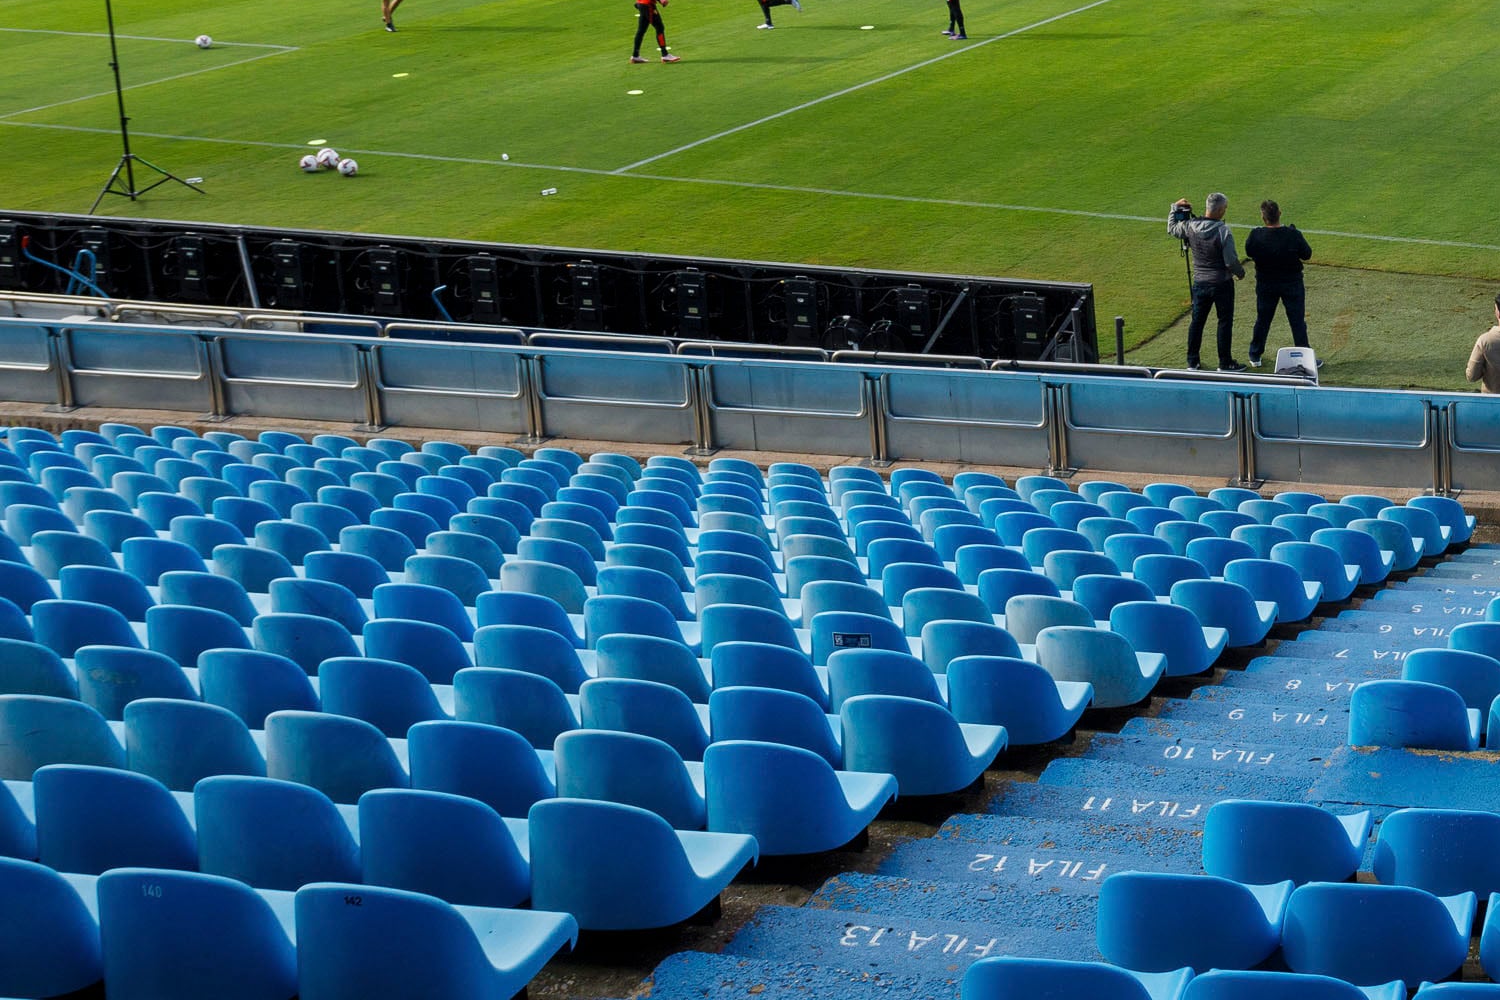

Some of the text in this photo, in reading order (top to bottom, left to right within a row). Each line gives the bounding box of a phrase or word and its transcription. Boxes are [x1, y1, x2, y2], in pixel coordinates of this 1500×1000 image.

[1411, 604, 1485, 617] FILA 5
[1379, 624, 1393, 634] 6
[1334, 648, 1350, 658] 7
[1285, 679, 1302, 690] 8
[1228, 708, 1329, 726] FILA 9
[1163, 745, 1275, 765] FILA 10
[1081, 796, 1201, 818] FILA 11
[968, 853, 1107, 881] FILA 12
[141, 884, 162, 898] 140
[840, 925, 998, 958] FILA 13
